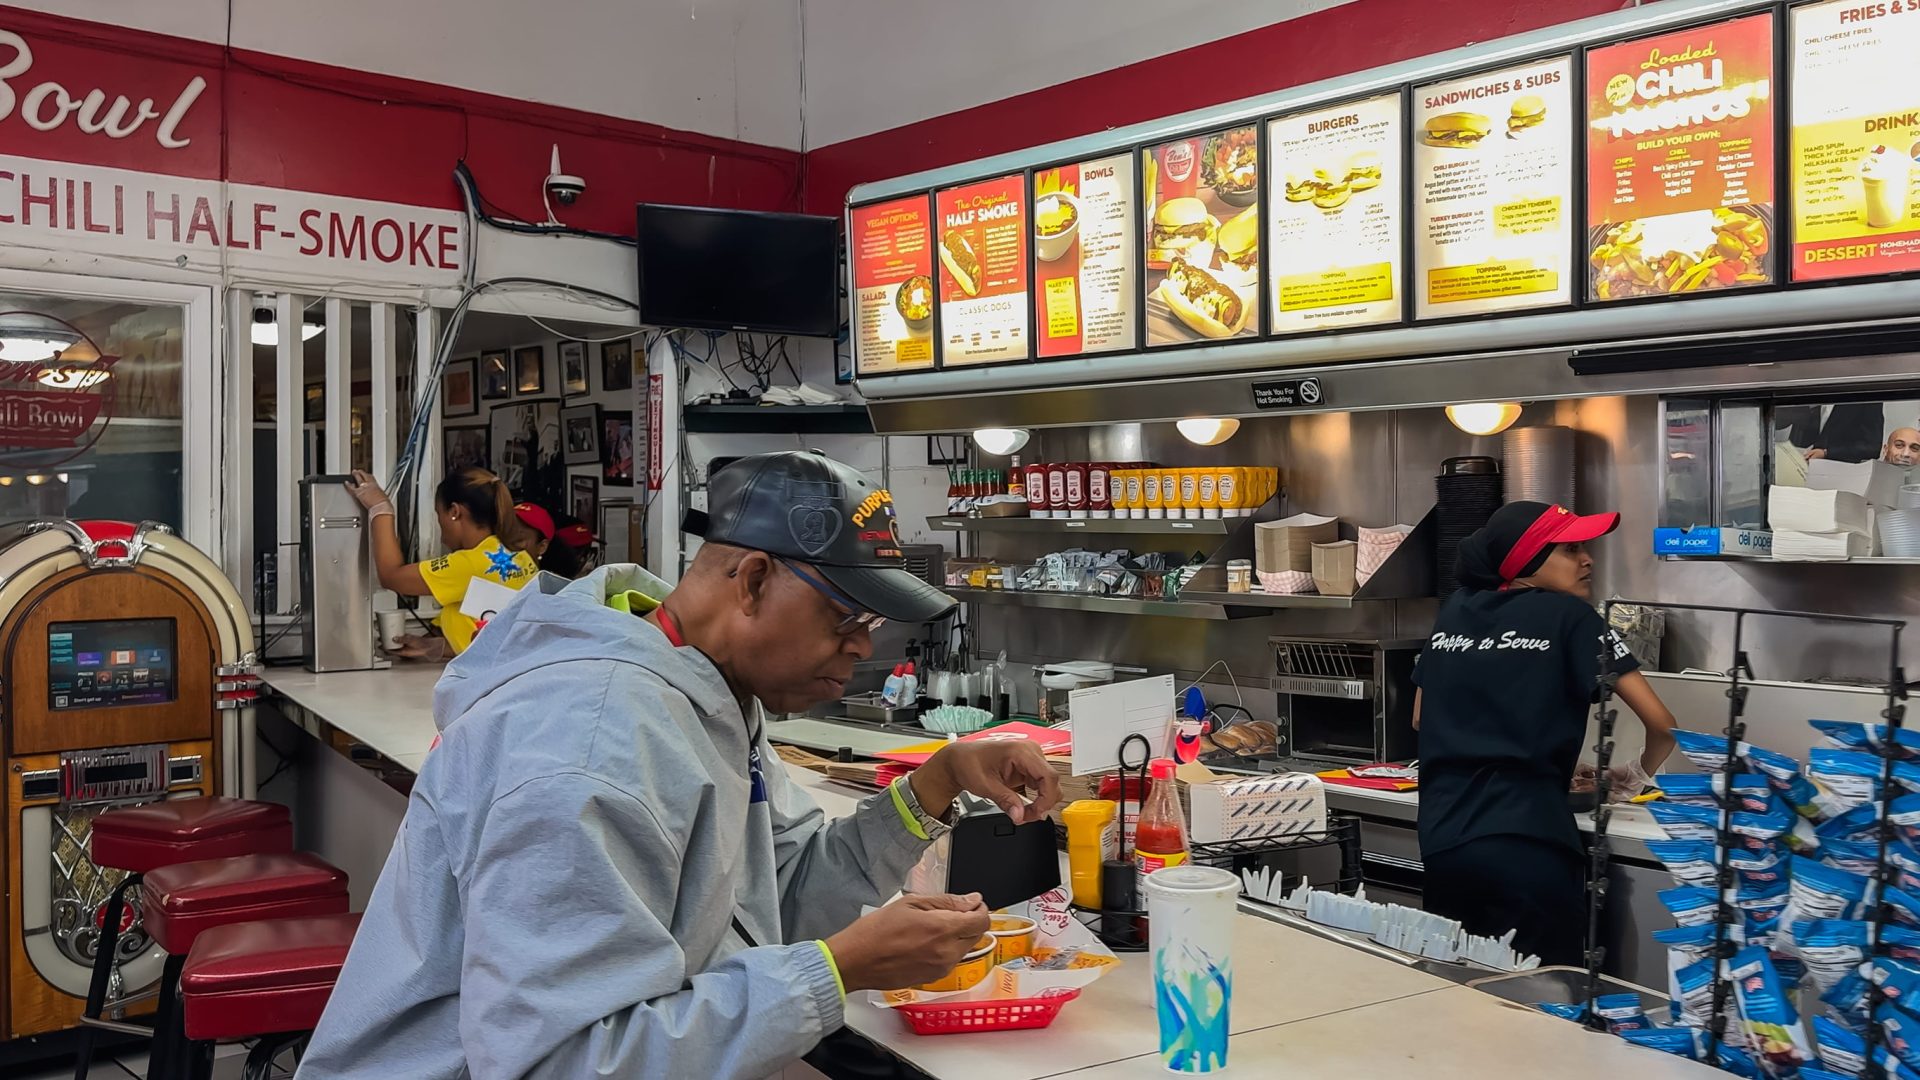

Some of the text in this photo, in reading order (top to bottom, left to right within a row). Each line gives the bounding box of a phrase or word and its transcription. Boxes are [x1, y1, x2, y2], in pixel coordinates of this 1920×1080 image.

[1839, 3, 1886, 24] FRIES
[1890, 0, 1903, 14] &
[1804, 37, 1822, 45] CHILI
[1824, 31, 1851, 41] CHEESE
[1640, 41, 1717, 70] Loaded
[1609, 78, 1628, 90] NEW
[1635, 58, 1723, 100] CHILI
[1425, 71, 1561, 109] SANDWICHES & SUBS
[1308, 115, 1360, 134] BURGERS
[1864, 111, 1920, 133] DRINK
[1636, 131, 1721, 151] BUILD YOUR OWN:
[1718, 138, 1752, 149] TOPPINGS
[1804, 145, 1824, 153] HAND
[1669, 148, 1686, 156] CHILI
[1836, 147, 1865, 156] CREAMY
[1804, 157, 1849, 167] MILKSHAKES
[1084, 167, 1114, 181] BOWLS
[972, 191, 1009, 210] Original
[890, 211, 919, 225] OPTIONS
[946, 201, 1019, 228] HALF SMOKE
[1430, 214, 1451, 223] TURKEY
[1451, 211, 1473, 221] BURGER
[147, 191, 459, 270] HALF-SMOKE
[1804, 244, 1879, 264] DESSERT
[1476, 265, 1507, 274] TOPPINGS
[862, 291, 887, 302] SALADS
[1255, 389, 1273, 397] Thank
[1268, 396, 1293, 404] Smoking
[28, 403, 84, 429] Bowl
[852, 489, 894, 528] PURPLE
[1664, 537, 1710, 550] deli paper
[1738, 531, 1772, 550] deli pape
[1431, 630, 1551, 653] Happy to Serve
